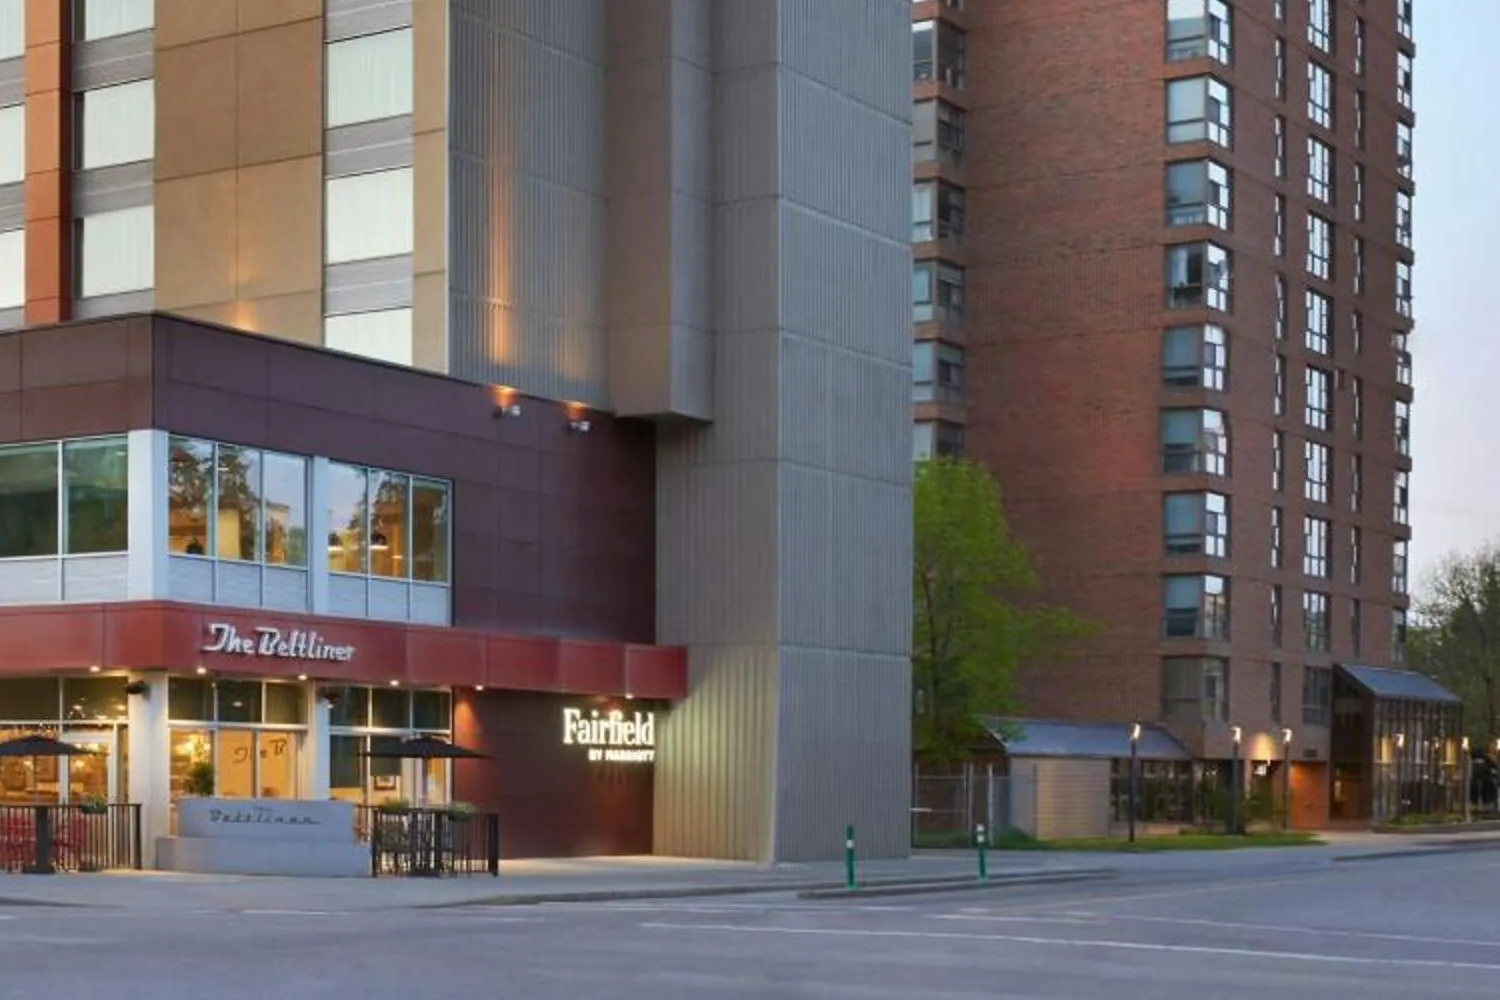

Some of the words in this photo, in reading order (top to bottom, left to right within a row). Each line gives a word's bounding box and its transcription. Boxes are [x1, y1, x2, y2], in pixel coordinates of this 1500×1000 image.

[202, 623, 255, 655] The
[254, 626, 356, 661] Beltliner
[563, 707, 655, 745] Fairfield
